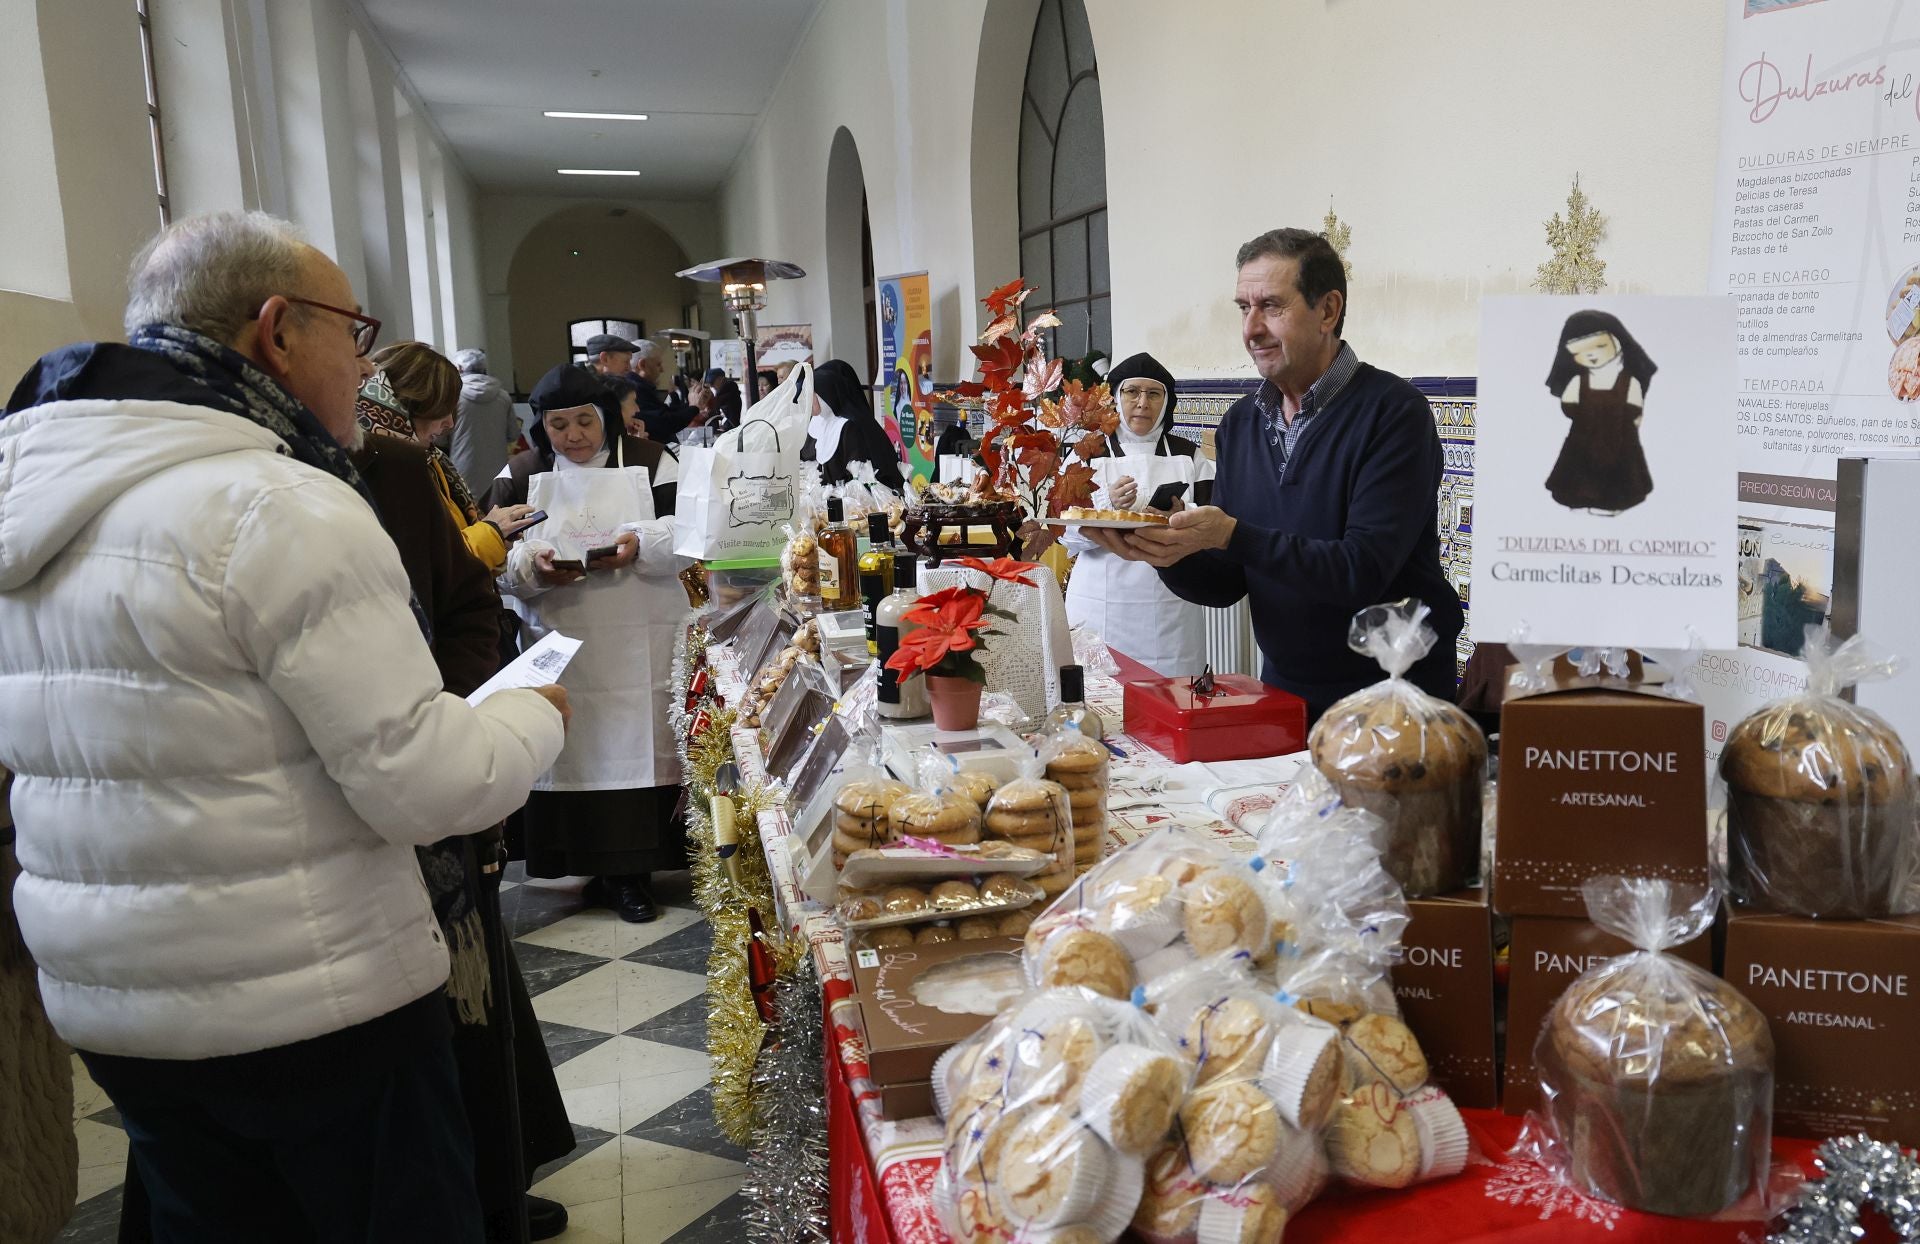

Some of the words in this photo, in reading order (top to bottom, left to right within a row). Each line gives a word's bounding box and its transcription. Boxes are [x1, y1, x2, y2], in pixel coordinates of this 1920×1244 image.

[1738, 51, 1887, 123] Dulzuras
[1883, 73, 1913, 108] del
[1738, 149, 1815, 169] DULDURAS
[1821, 146, 1840, 160] DE
[1845, 134, 1911, 155] SIEMPRE
[1736, 173, 1792, 189] Magdalenas
[1794, 166, 1852, 182] bizcochadas
[1735, 189, 1770, 202] Delicias
[1773, 188, 1786, 199] de
[1789, 185, 1818, 197] Teresa
[1734, 204, 1764, 216] Pastas
[1767, 202, 1804, 213] caseras
[1733, 217, 1764, 229] Pastas
[1766, 216, 1781, 227] del
[1783, 213, 1819, 225] Carmen
[1732, 231, 1774, 243] Bizcocho
[1776, 229, 1789, 240] de
[1791, 227, 1810, 239] San
[1811, 226, 1833, 238] Zoilo
[1731, 244, 1761, 256] Pastas
[1763, 244, 1776, 254] de
[1778, 243, 1788, 253] té
[1729, 273, 1757, 285] POR
[1763, 268, 1830, 284] ENCARGO
[1728, 291, 1775, 303] panada
[1777, 290, 1790, 301] de
[1792, 290, 1820, 301] bonito
[1776, 304, 1789, 315] de
[1790, 305, 1816, 315] carne
[1748, 331, 1760, 342] de
[1762, 331, 1808, 343] almendras
[1810, 331, 1863, 342] Carmelitana
[1752, 346, 1764, 356] de
[1766, 346, 1819, 357] cumpleaños
[1743, 378, 1825, 392] TEMPORADA
[1738, 398, 1783, 409] NAVALES:
[1785, 400, 1829, 412] Horejuelas
[1753, 412, 1773, 423] LOS
[1775, 413, 1815, 425] SANTOS:
[1817, 414, 1859, 427] Buñuelos,
[1861, 418, 1879, 429] pan
[1881, 417, 1893, 428] de
[1895, 417, 1909, 429] los
[1737, 424, 1760, 436] DAD:
[1762, 426, 1805, 439] Panetone,
[1807, 430, 1856, 442] polvorones,
[1859, 433, 1889, 443] roscos
[1891, 434, 1912, 445] vino,
[1762, 440, 1803, 452] sultanitas
[1804, 444, 1810, 454] y
[1740, 480, 1779, 495] PRECIO
[1780, 484, 1816, 500] SEGÚN
[1592, 538, 1623, 553] DEL
[1491, 561, 1602, 584] Carmelitas
[1611, 565, 1723, 587] Descalzas
[1698, 654, 1740, 675] ECIOS
[1743, 662, 1752, 677] Y
[1524, 746, 1678, 773] PANETTONE
[1560, 792, 1647, 808] ARTESANAL
[1749, 963, 1909, 996] PANETTONE
[1786, 1011, 1876, 1030] ARTESANAL
